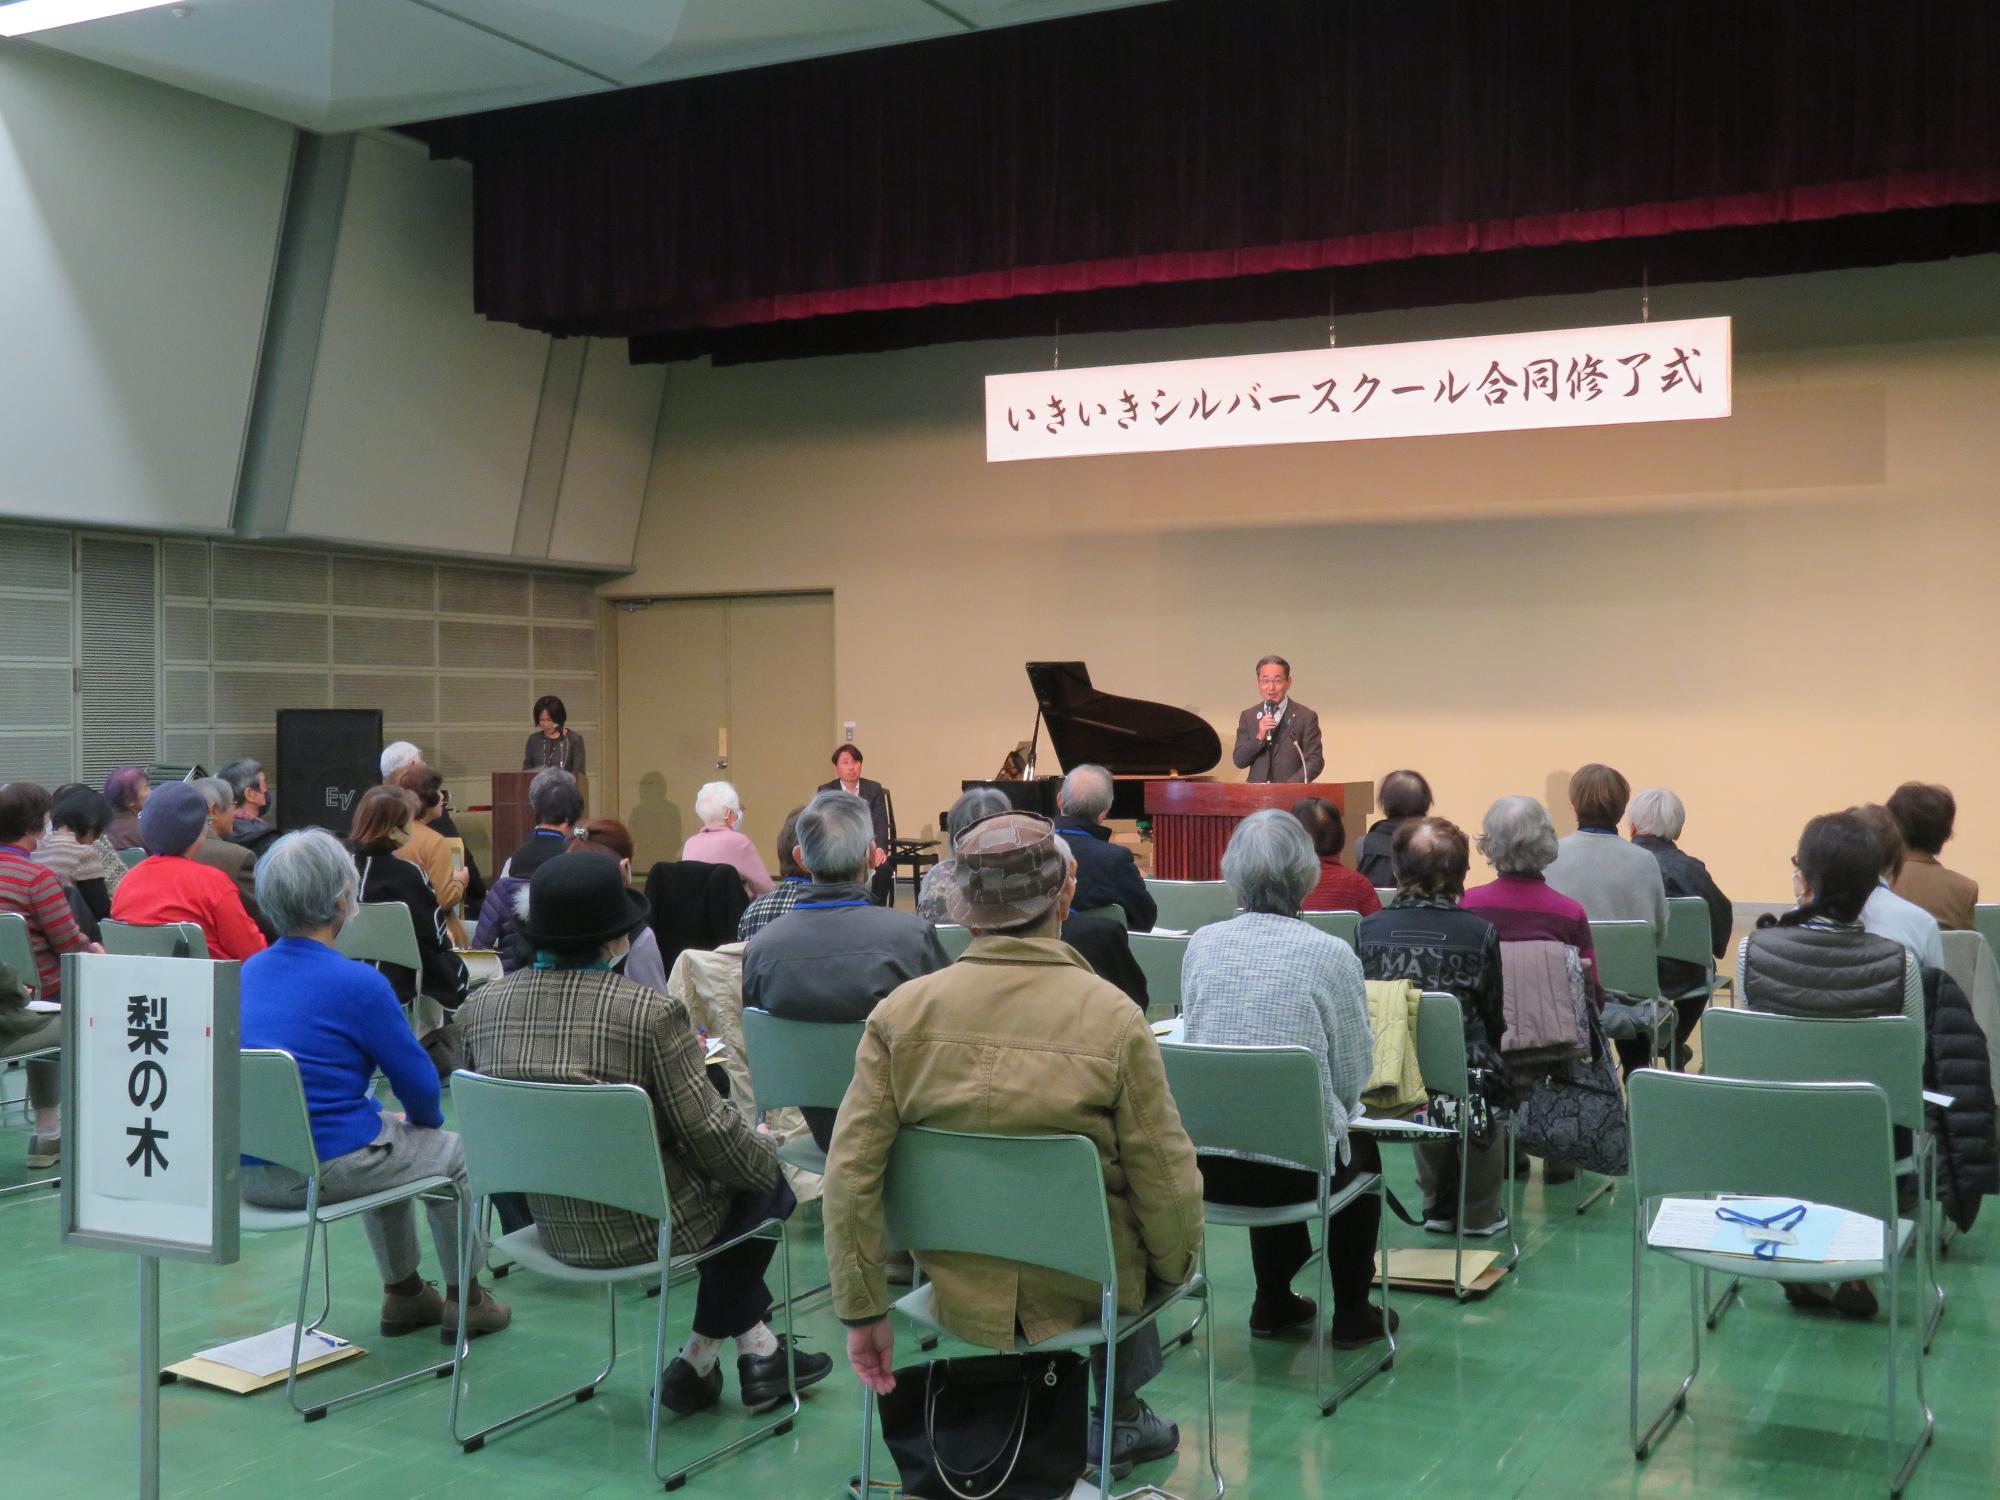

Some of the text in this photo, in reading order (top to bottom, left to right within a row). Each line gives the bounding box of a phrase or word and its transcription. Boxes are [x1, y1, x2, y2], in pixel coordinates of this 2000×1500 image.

[1007, 347, 1703, 434] いきいきシルバースクール合同修了式
[126, 995, 169, 1177] 梨の木
